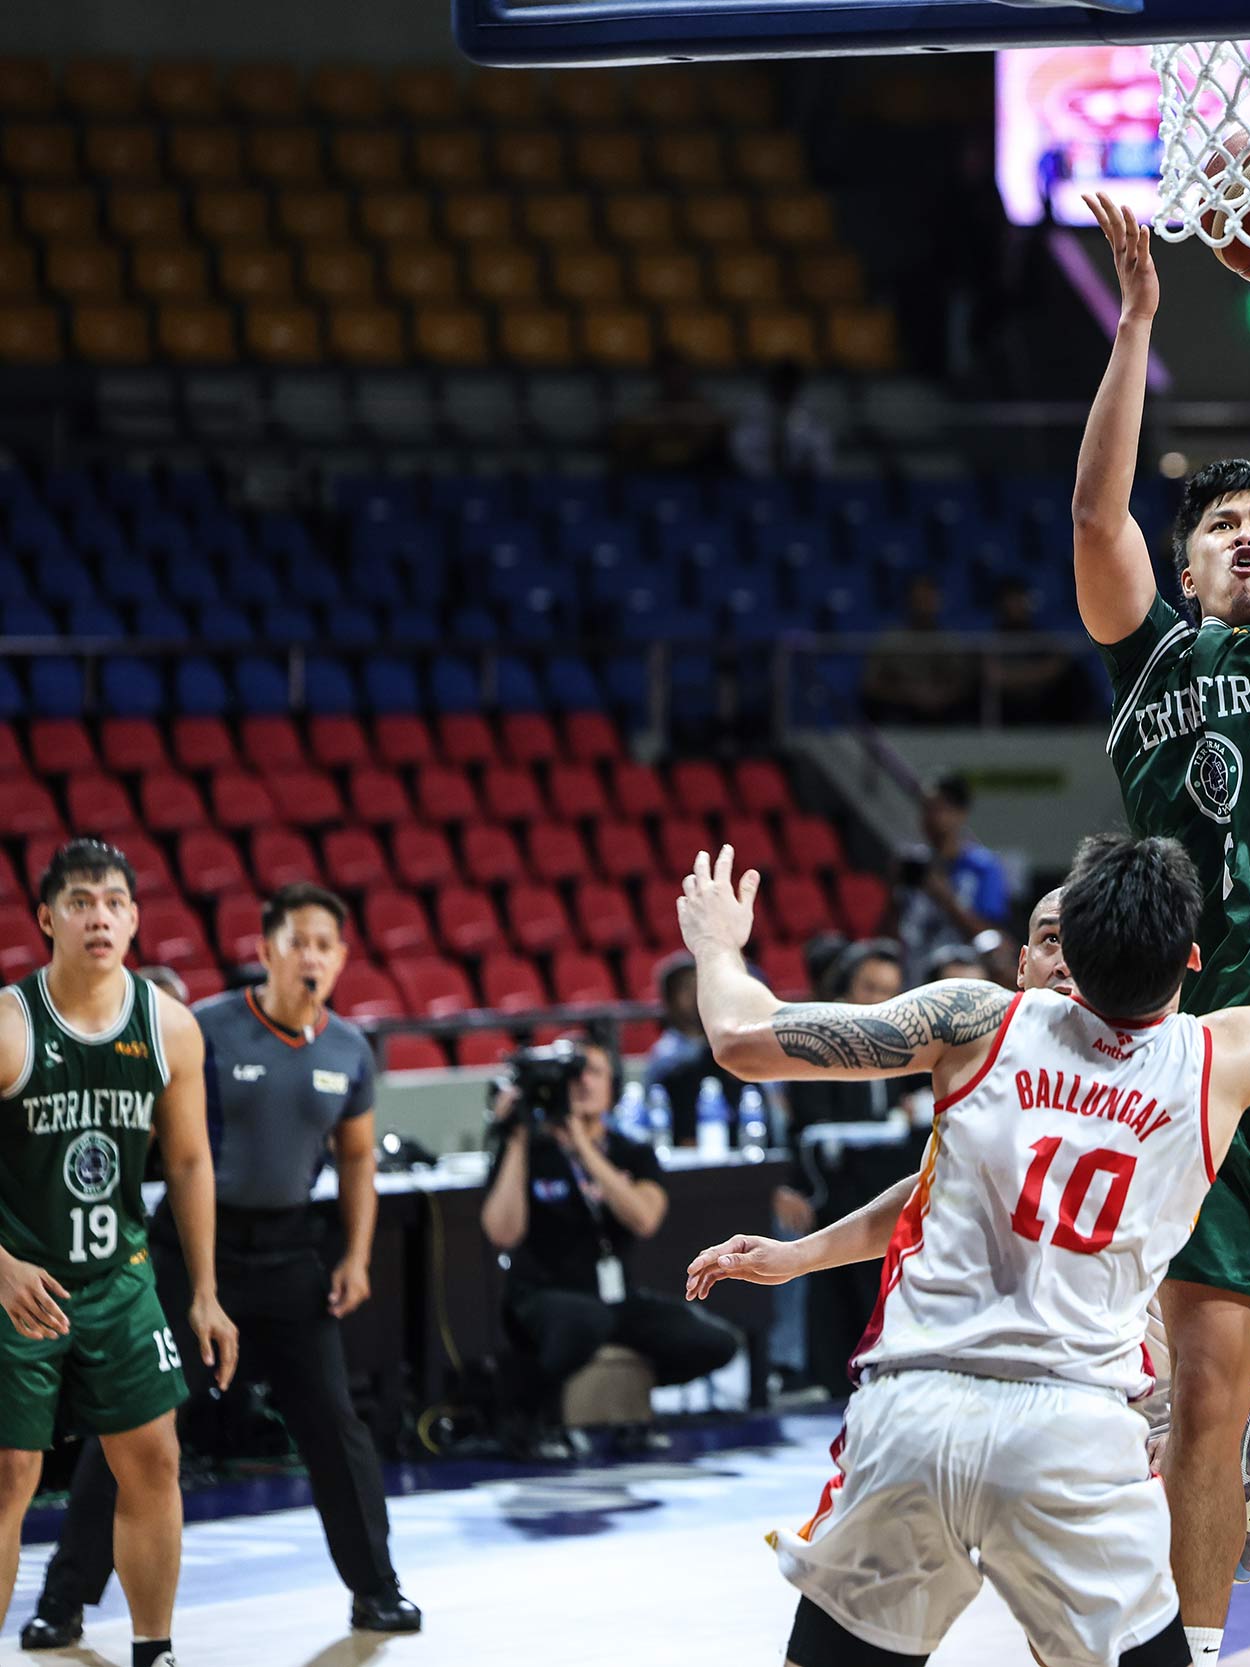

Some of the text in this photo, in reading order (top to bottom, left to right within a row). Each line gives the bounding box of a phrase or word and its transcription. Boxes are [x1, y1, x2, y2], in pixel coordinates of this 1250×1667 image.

[1015, 1068, 1172, 1143] BALLUNGAY
[1010, 1135, 1138, 1255] 10
[69, 1204, 118, 1263] 19
